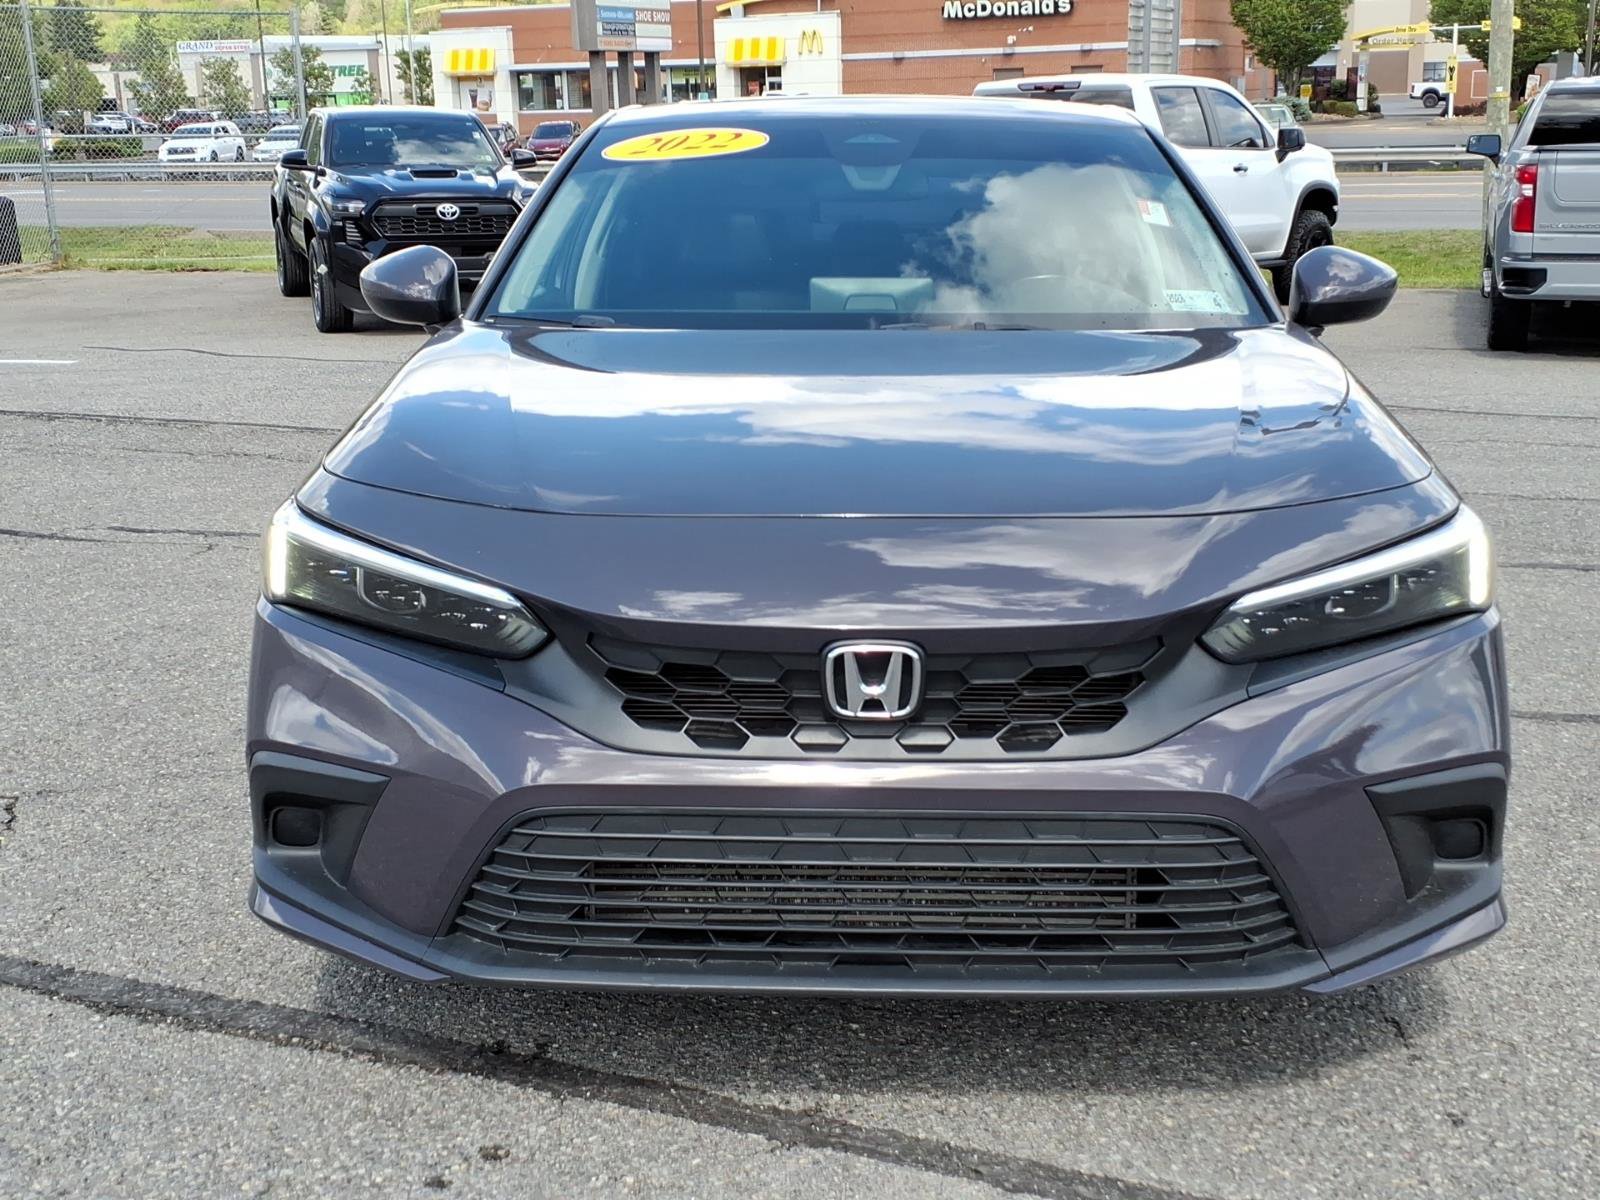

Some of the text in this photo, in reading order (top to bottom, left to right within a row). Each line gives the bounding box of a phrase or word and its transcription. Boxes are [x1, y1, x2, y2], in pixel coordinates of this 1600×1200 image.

[943, 0, 1071, 19] McDonald's
[635, 10, 671, 22] SHOE SHOW
[178, 41, 213, 51] GRAND
[1372, 37, 1394, 45] Order
[329, 64, 365, 77] TREE
[628, 132, 743, 155] 2022
